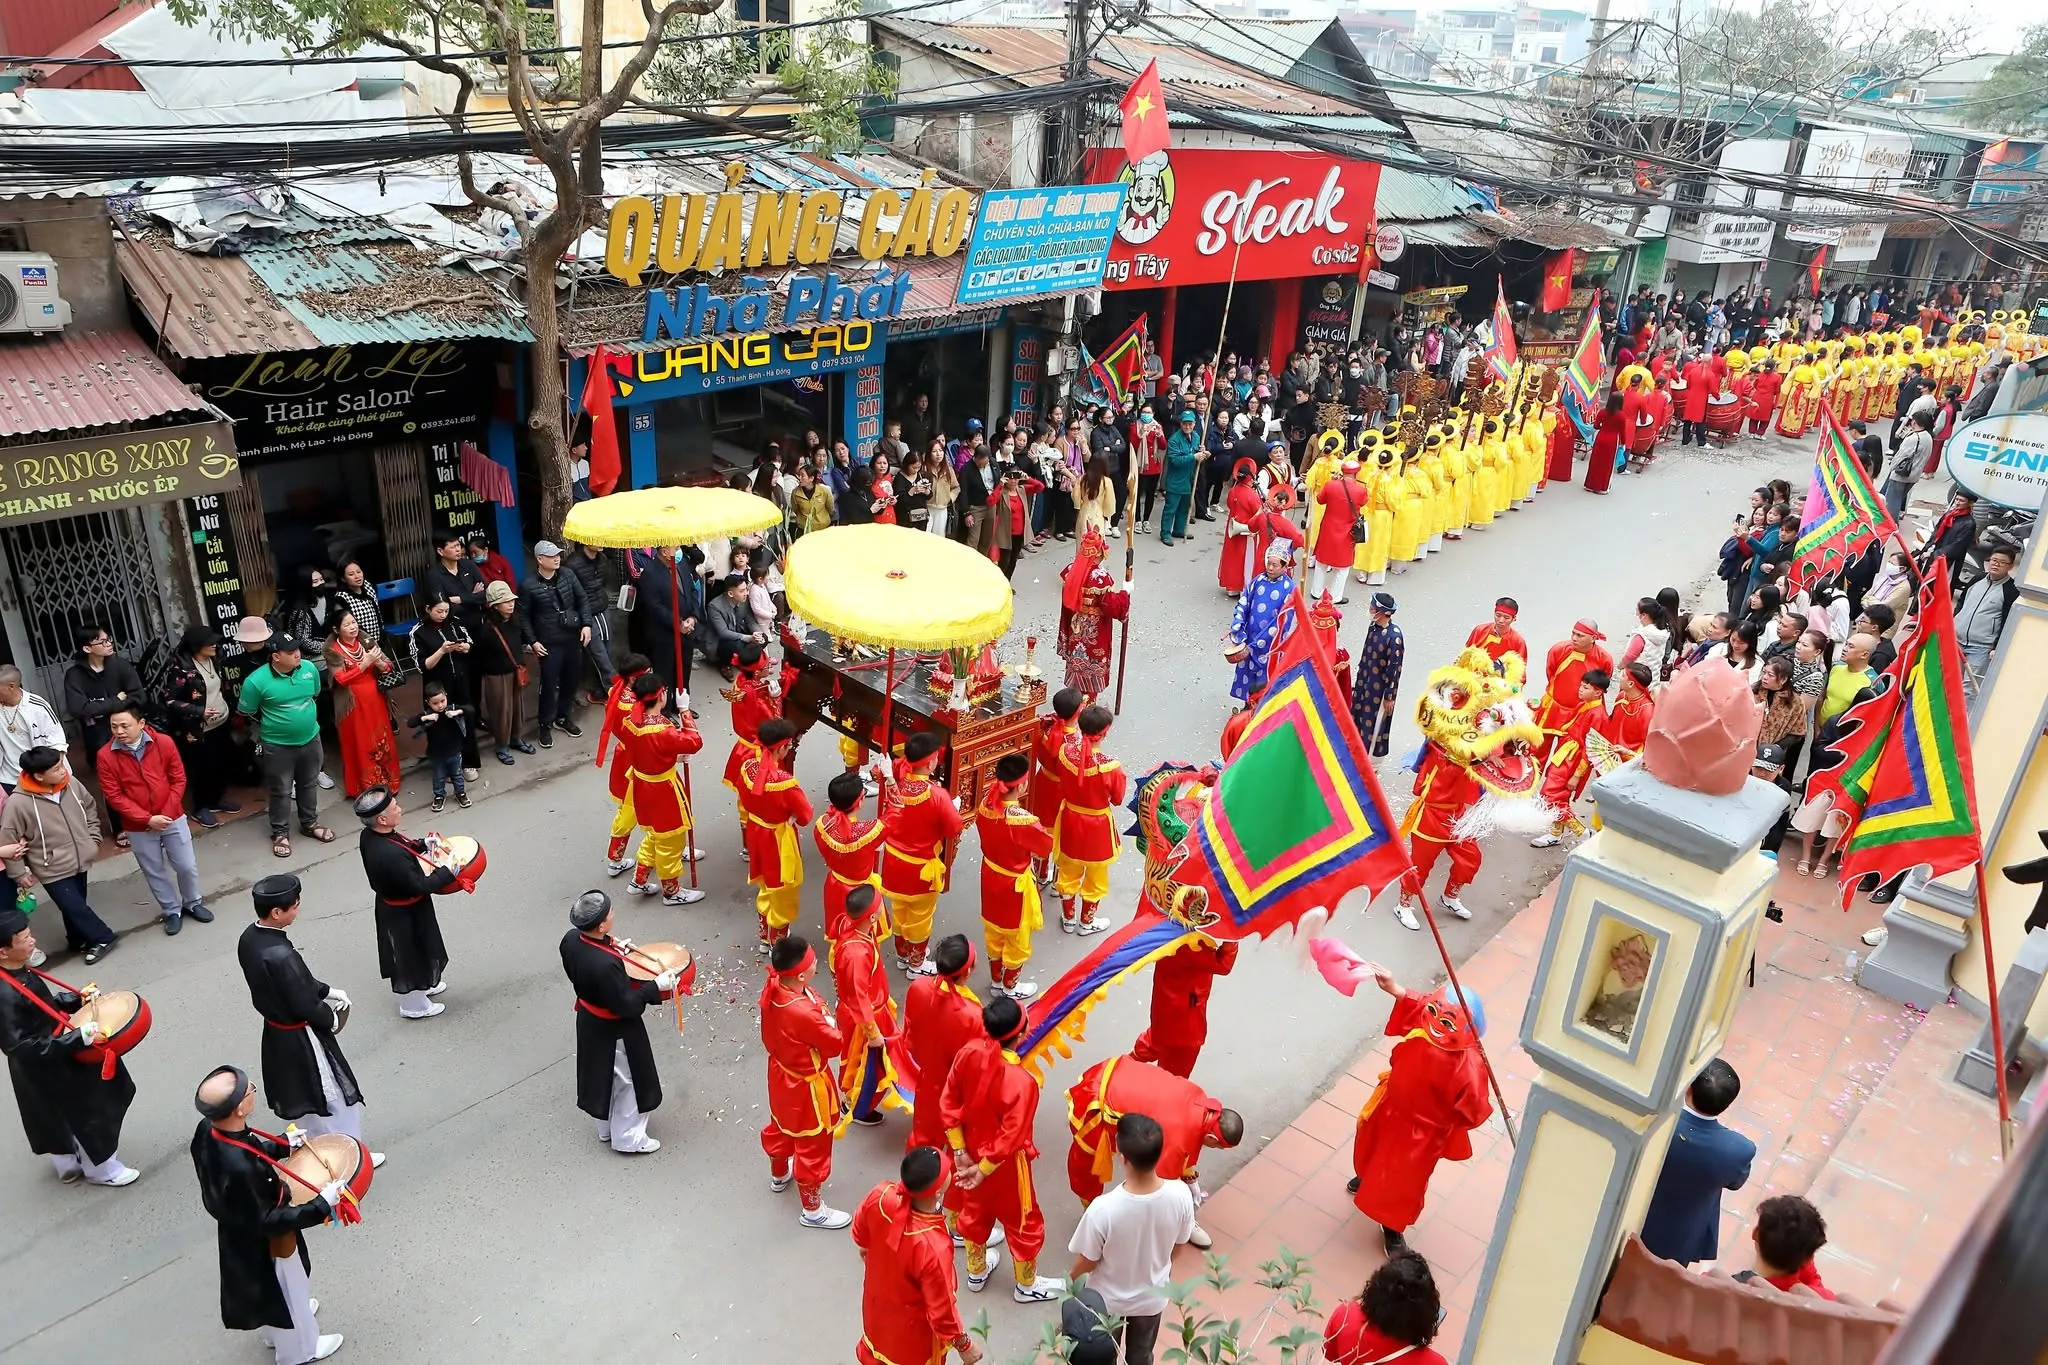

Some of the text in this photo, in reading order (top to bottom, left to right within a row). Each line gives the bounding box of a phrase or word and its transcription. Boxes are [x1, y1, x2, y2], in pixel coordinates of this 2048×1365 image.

[1017, 192, 1049, 220] MÁY
[1196, 165, 1349, 256] Steak
[605, 161, 970, 287] QUẢNG CÁO
[984, 224, 1024, 241] CHUYÊN
[1026, 219, 1045, 237] SỬA
[1094, 216, 1111, 230] MỚI
[973, 245, 993, 267] CÁC
[992, 247, 1011, 267] LOẠI
[1010, 242, 1034, 262] MÁY
[1050, 239, 1071, 260] ĐIỆN
[1348, 244, 1360, 263] 2
[1105, 259, 1131, 283] ng
[1135, 253, 1170, 281] Tây
[643, 268, 913, 342] Nhã Phát
[1305, 322, 1346, 342] GIẢM GIÁ
[822, 354, 865, 368] 0979 333 104
[716, 376, 726, 385] 55
[728, 374, 747, 383] Thanh
[857, 375, 880, 397] CHỮA
[264, 388, 411, 424] Hair Salon
[857, 397, 880, 418] BÁN
[306, 420, 326, 432] đẹp
[328, 416, 355, 429] cùng
[356, 411, 379, 422] thời
[379, 410, 404, 423] gian
[421, 415, 477, 430] 0393.241.686
[635, 415, 650, 429] 55
[858, 417, 879, 439] MỚI
[262, 444, 288, 454] Bình,
[290, 441, 306, 450] Mộ
[308, 439, 326, 447] Lao
[333, 434, 346, 443] Hà
[348, 431, 373, 441] Đông
[1982, 432, 1996, 440] BẾP
[432, 443, 448, 463] Trị
[15, 449, 118, 489] RANG
[125, 438, 190, 473] XAY
[436, 465, 454, 483] Vai
[2018, 474, 2033, 484] Với
[89, 479, 149, 504] NƯỚC
[154, 474, 180, 493] ÉP
[192, 494, 218, 511] Tóc
[434, 490, 450, 510] Đả
[200, 514, 220, 531] Nữ
[448, 508, 476, 528] Body
[205, 536, 224, 555] Cắt
[207, 556, 229, 575] Uốn
[203, 578, 240, 597] Nhuộm
[216, 601, 238, 620] Chà
